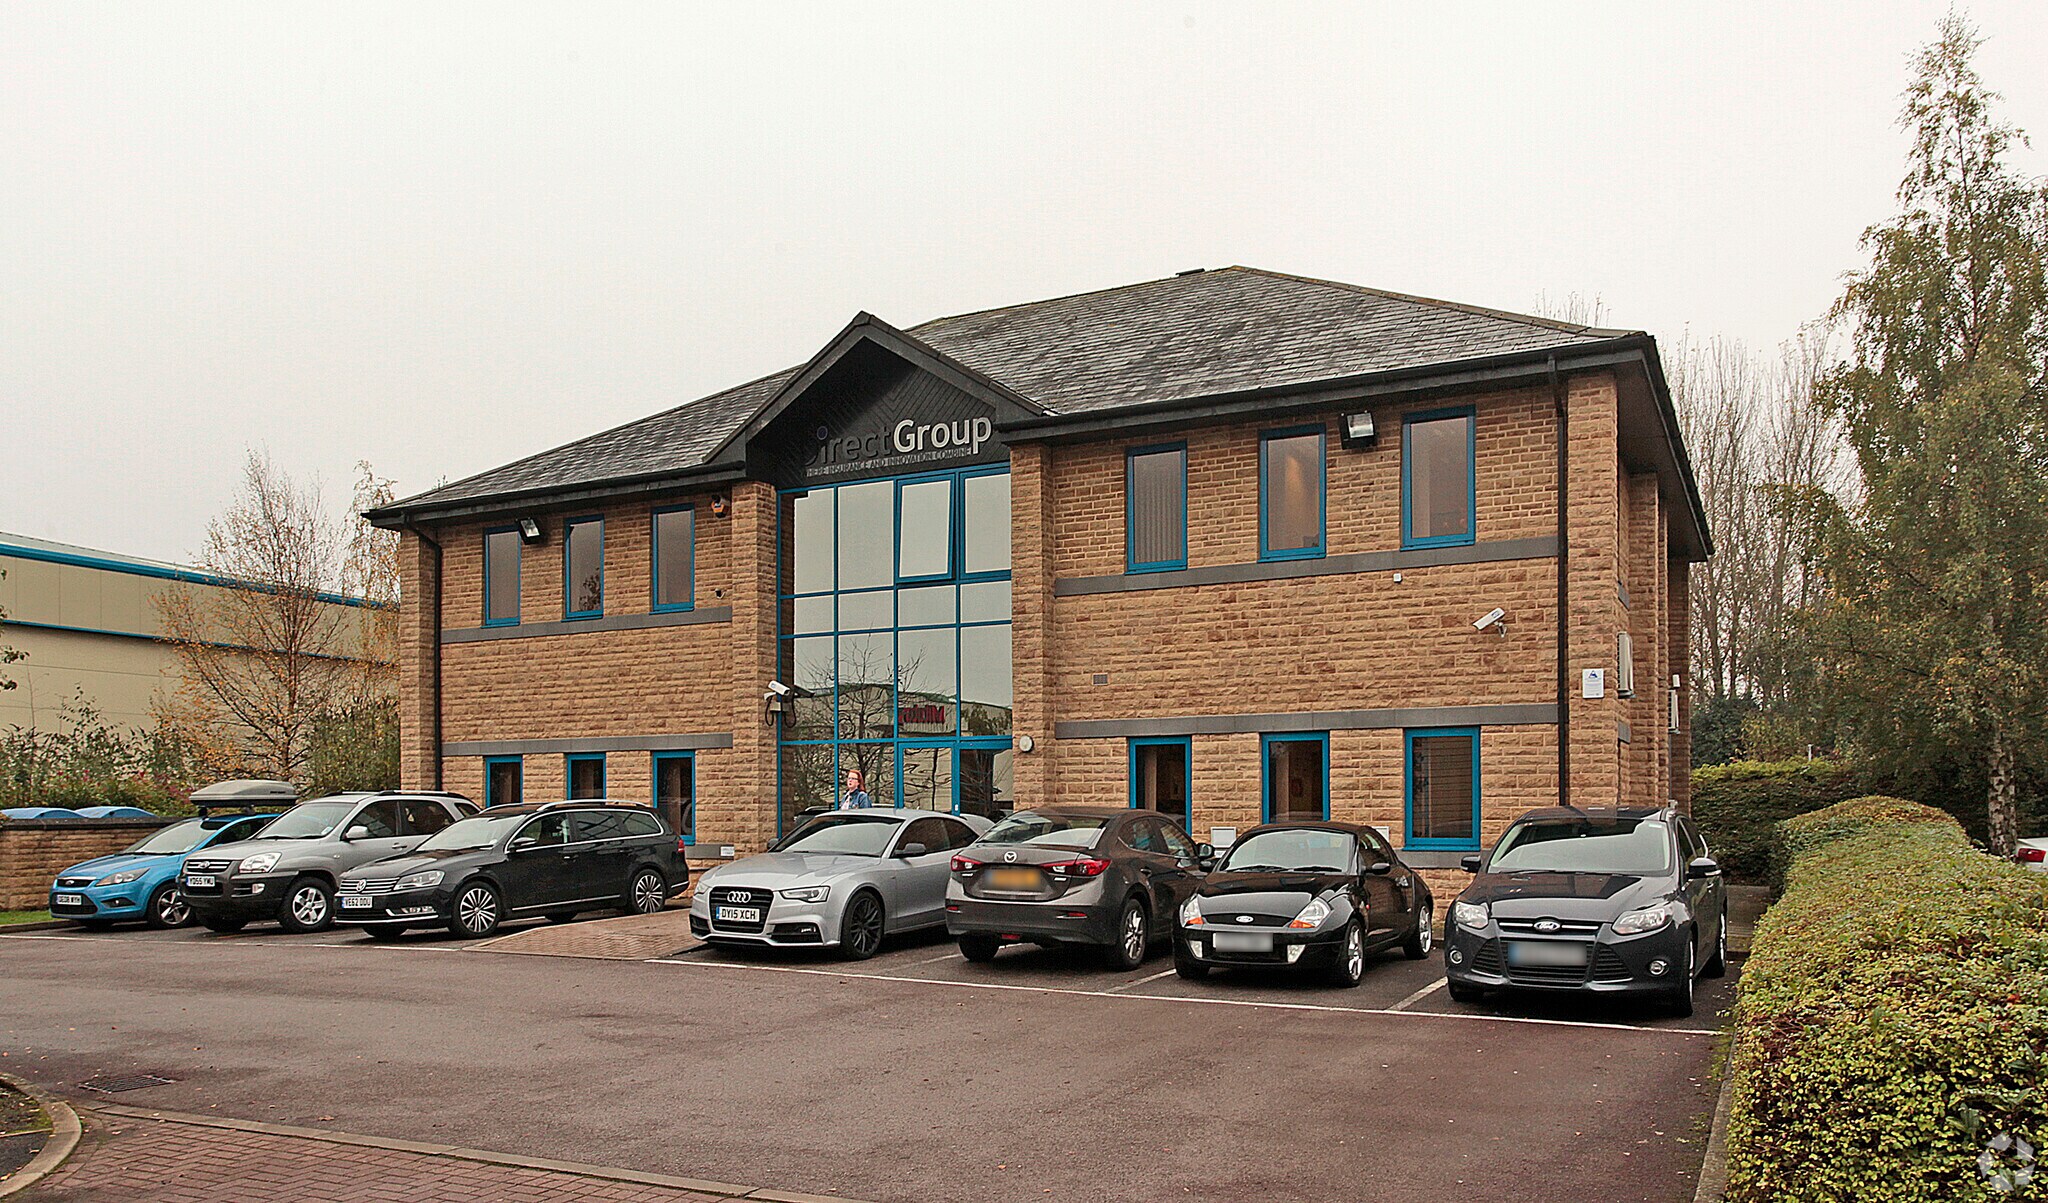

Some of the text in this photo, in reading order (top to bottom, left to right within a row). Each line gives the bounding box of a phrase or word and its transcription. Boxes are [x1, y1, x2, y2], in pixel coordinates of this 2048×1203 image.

[804, 416, 992, 466] irectGroup
[829, 459, 869, 475] INSURANCE
[870, 457, 885, 469] AND
[887, 451, 933, 467] INNOVATION
[721, 908, 756, 920] DY15 XCH
